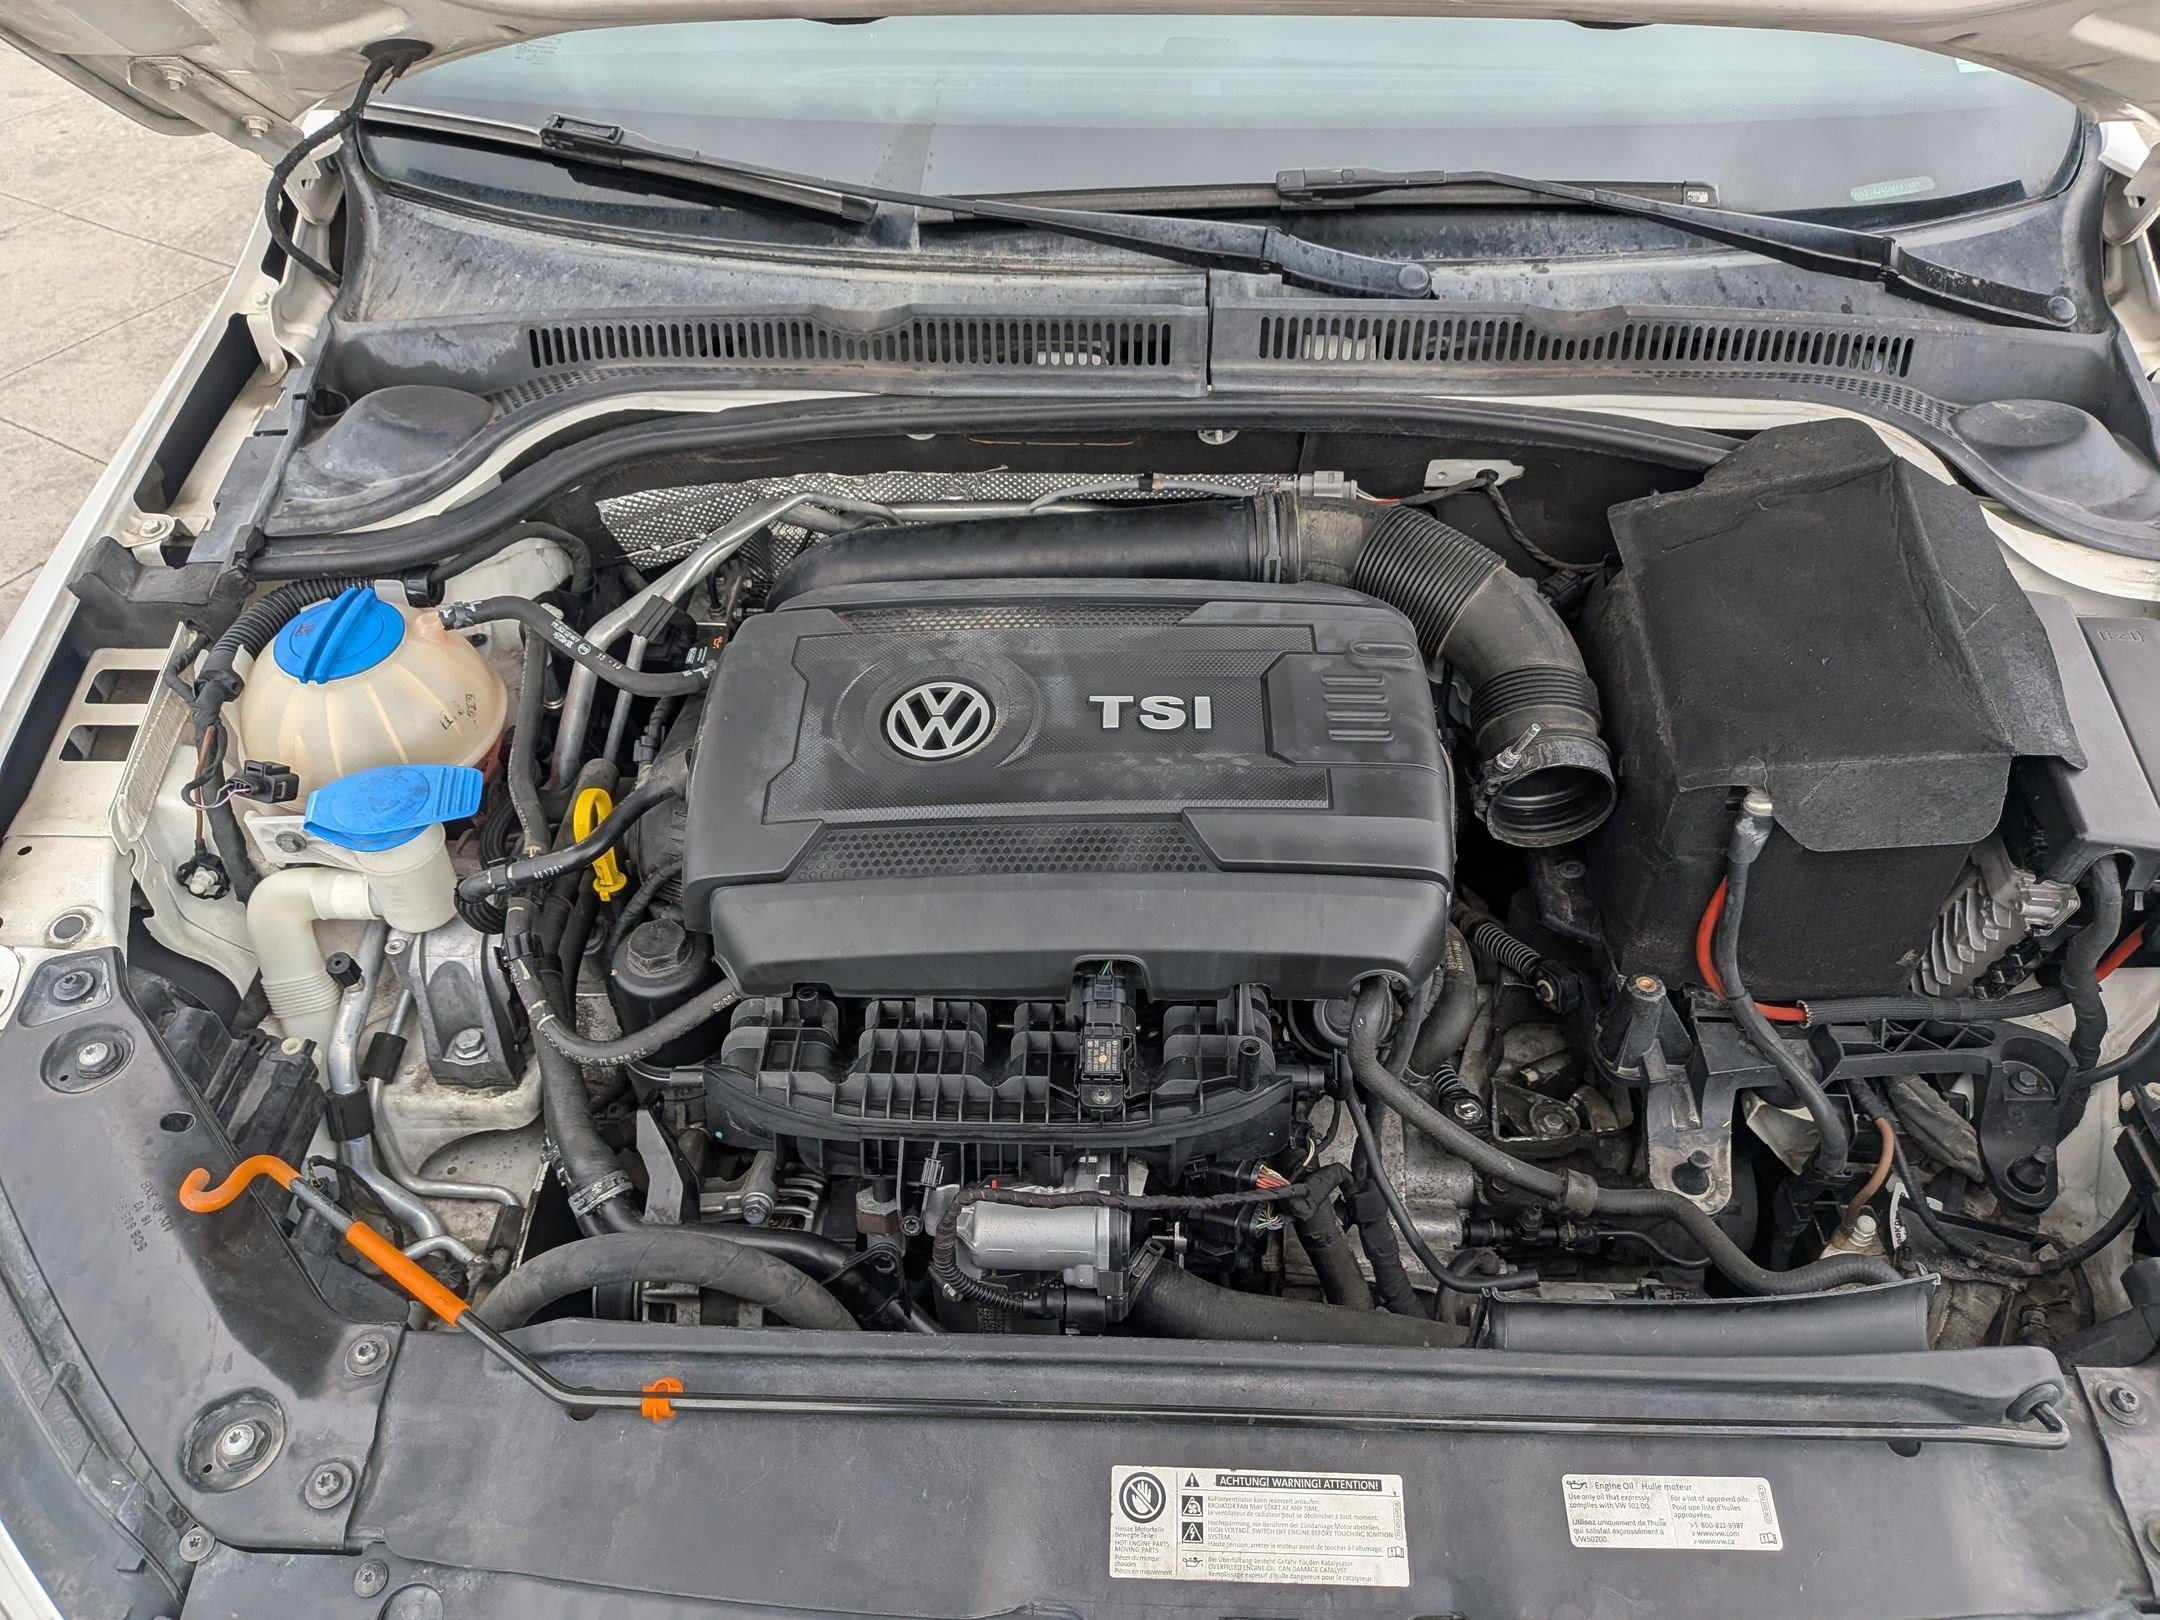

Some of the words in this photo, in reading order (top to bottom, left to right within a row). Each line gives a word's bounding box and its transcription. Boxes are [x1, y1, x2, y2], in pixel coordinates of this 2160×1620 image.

[1089, 695, 1212, 730] TSI
[1220, 1476, 1270, 1487] ACHTUNG!
[1272, 1478, 1322, 1488] WARNING!
[1324, 1480, 1379, 1490] ATTENTION!
[1595, 1482, 1621, 1492] Engine
